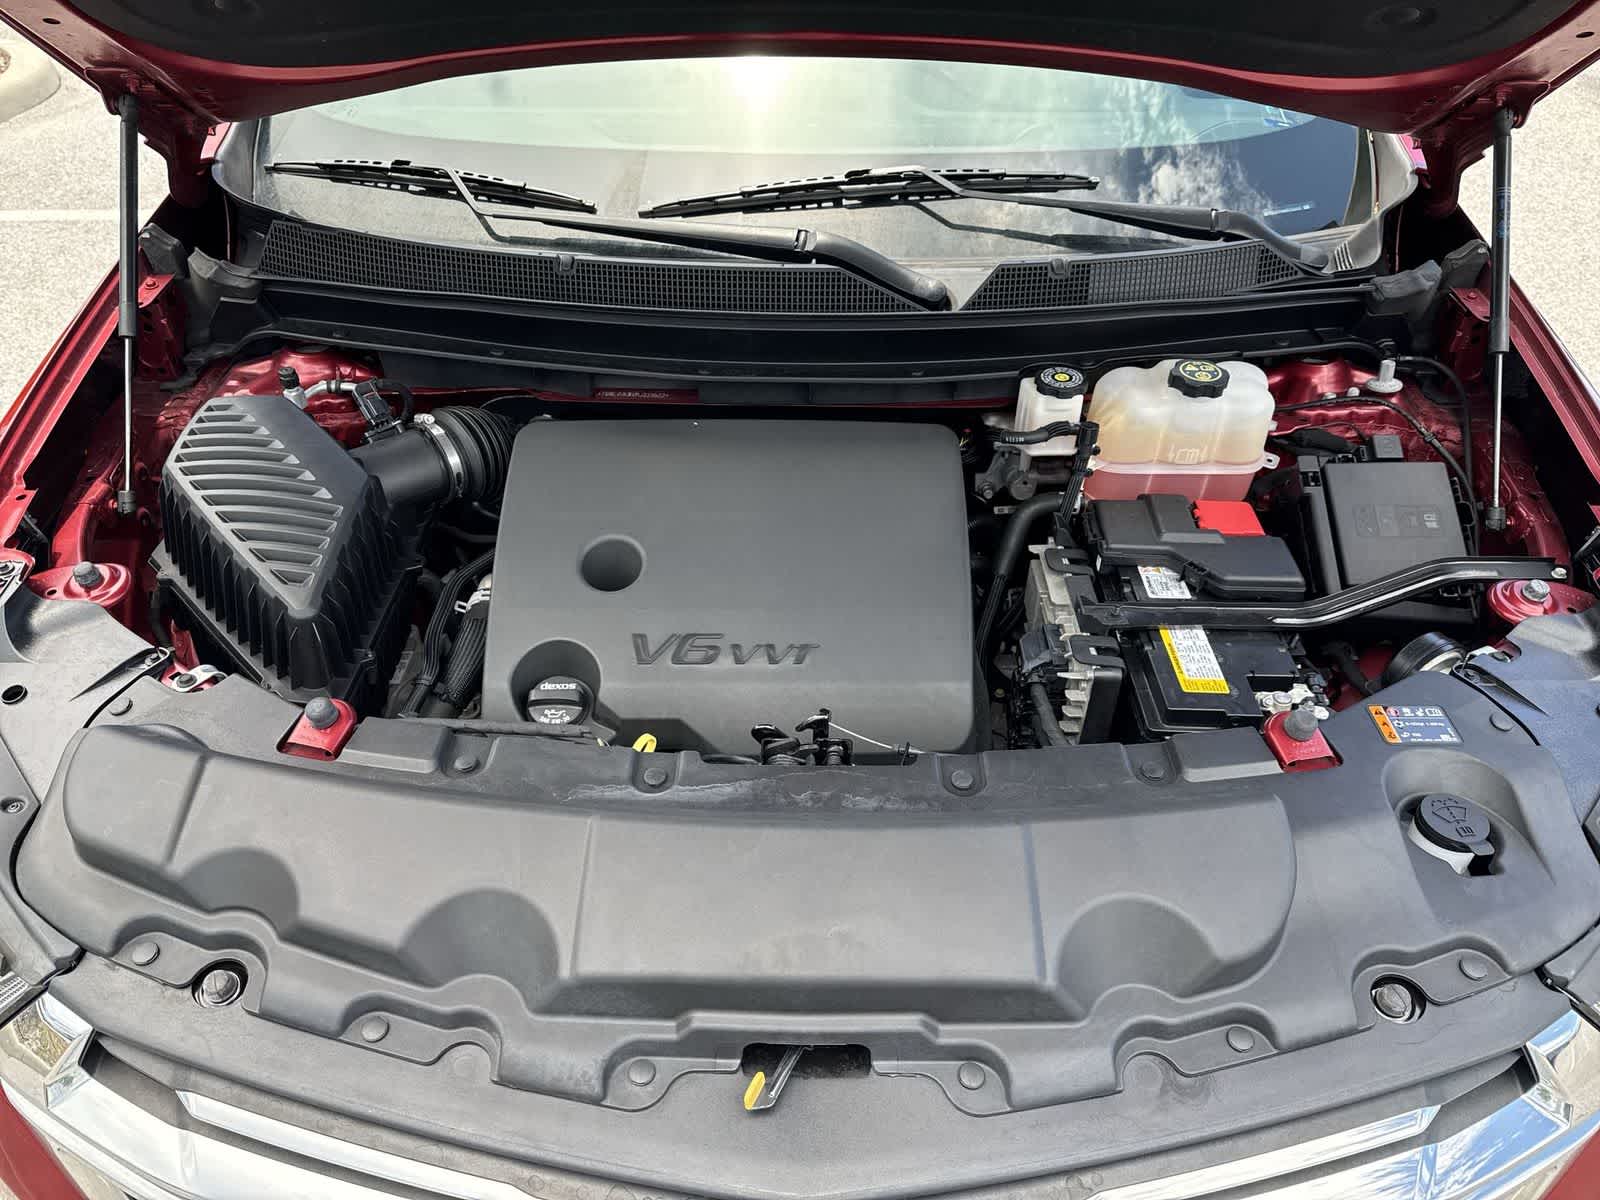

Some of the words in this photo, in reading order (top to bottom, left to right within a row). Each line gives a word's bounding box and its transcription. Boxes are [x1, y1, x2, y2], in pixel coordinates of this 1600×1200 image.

[632, 633, 725, 665] V6
[730, 643, 821, 665] VVT
[540, 682, 577, 690] dexos
